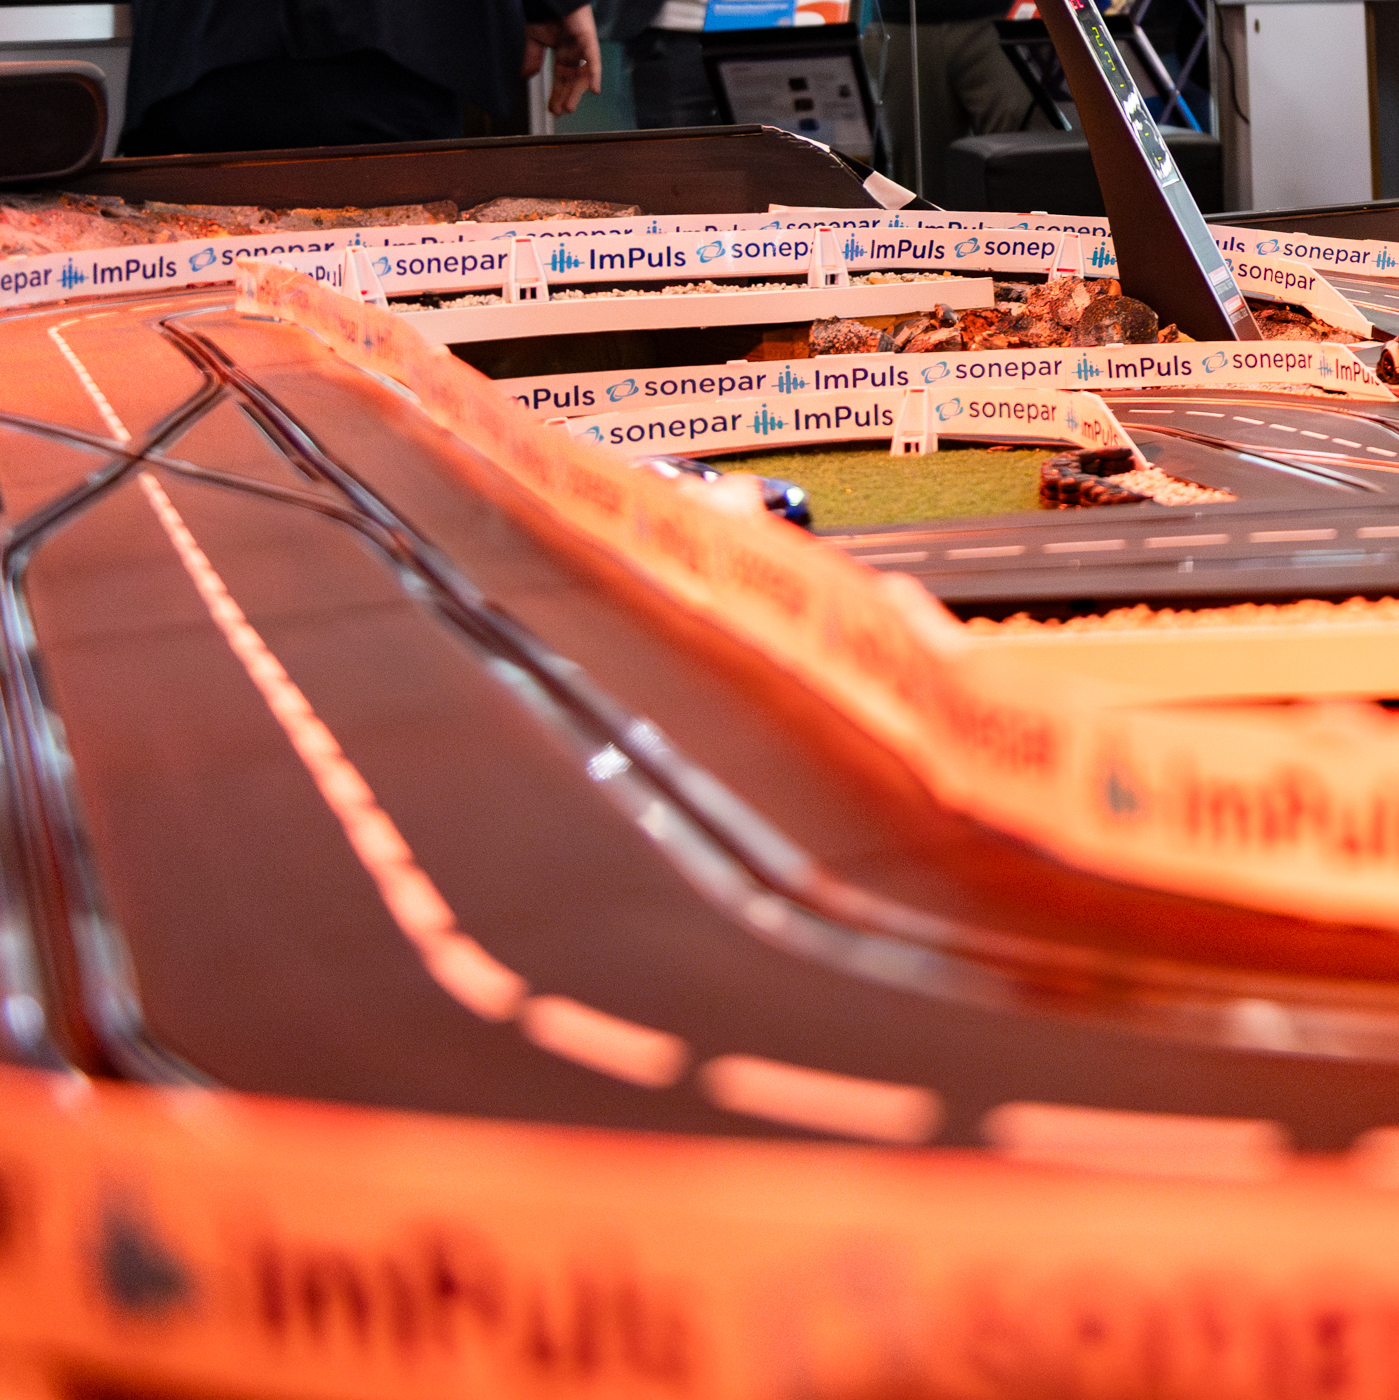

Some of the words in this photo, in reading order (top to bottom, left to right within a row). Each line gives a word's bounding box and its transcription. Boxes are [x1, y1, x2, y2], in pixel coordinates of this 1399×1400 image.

[395, 252, 508, 277] sonepar
[590, 245, 687, 271] ImPuls
[870, 238, 946, 260] ImPuls
[984, 239, 1056, 260] sonep
[1283, 242, 1371, 266] sonepar
[0, 267, 52, 294] epar
[92, 256, 177, 285] ImPuls
[1237, 260, 1316, 291] sonepar
[644, 373, 767, 397] sonepar
[815, 364, 910, 391] ImPuls
[955, 358, 1063, 380] sonepar
[1107, 354, 1193, 380] ImPuls
[1232, 351, 1313, 372] sonepar
[610, 412, 742, 445] sonepar
[794, 403, 894, 431] ImPuls
[969, 400, 1058, 423] sonepar
